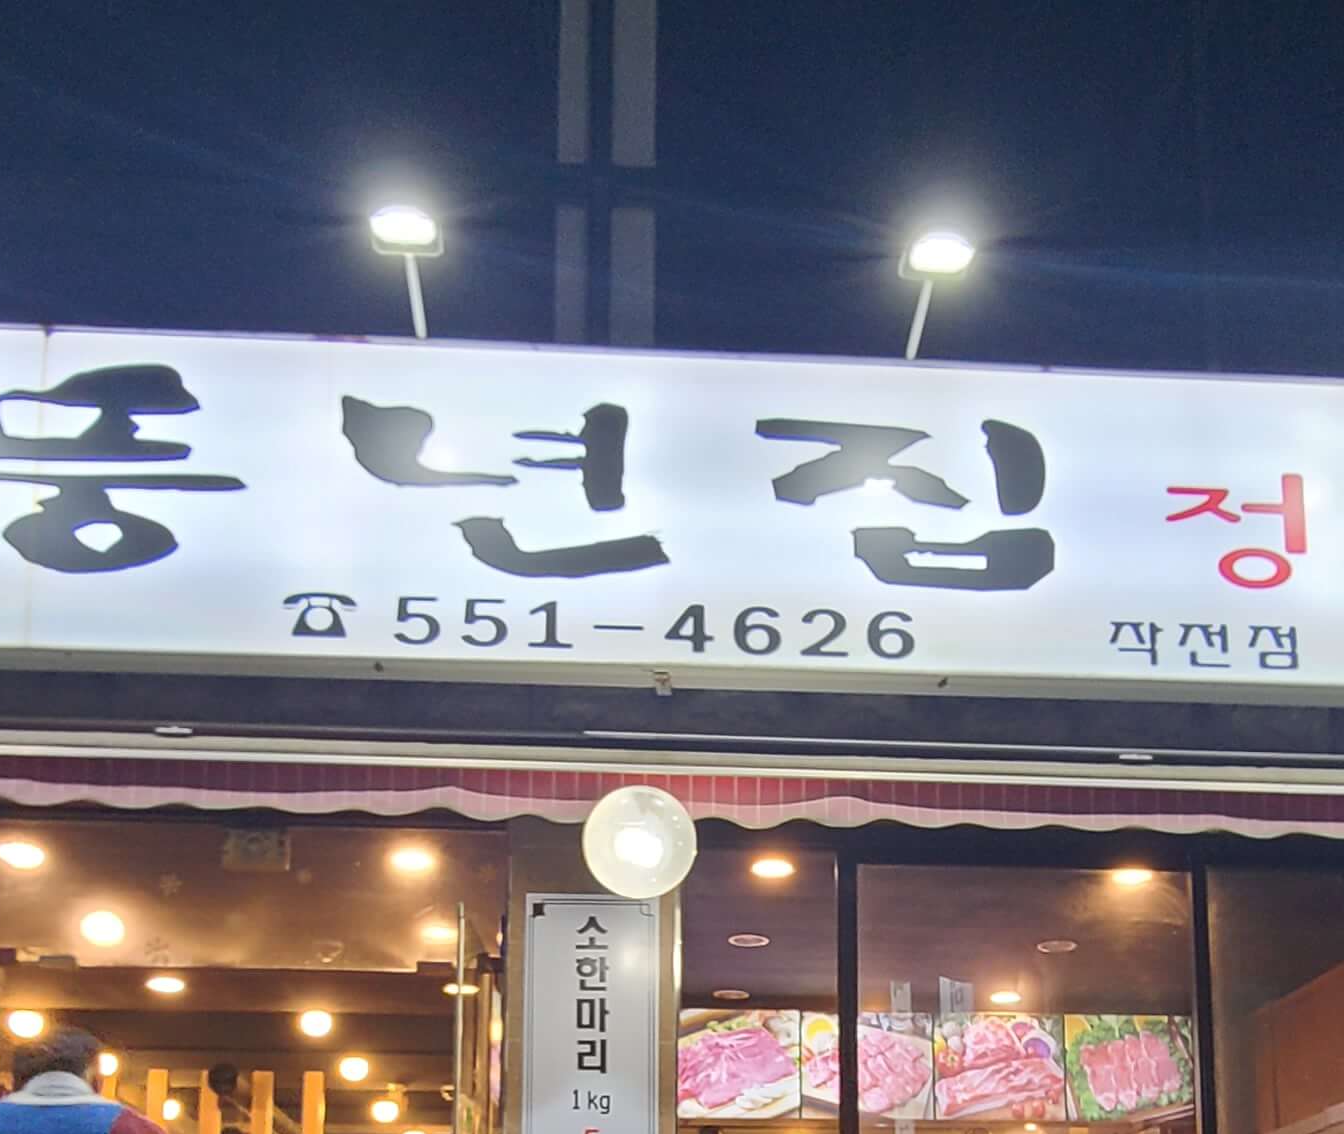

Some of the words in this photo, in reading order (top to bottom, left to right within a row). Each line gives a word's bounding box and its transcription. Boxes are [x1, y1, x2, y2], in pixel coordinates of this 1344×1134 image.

[392, 595, 917, 661] 551-4626
[1108, 621, 1300, 671] 작전점
[575, 915, 610, 1075] 소한마리
